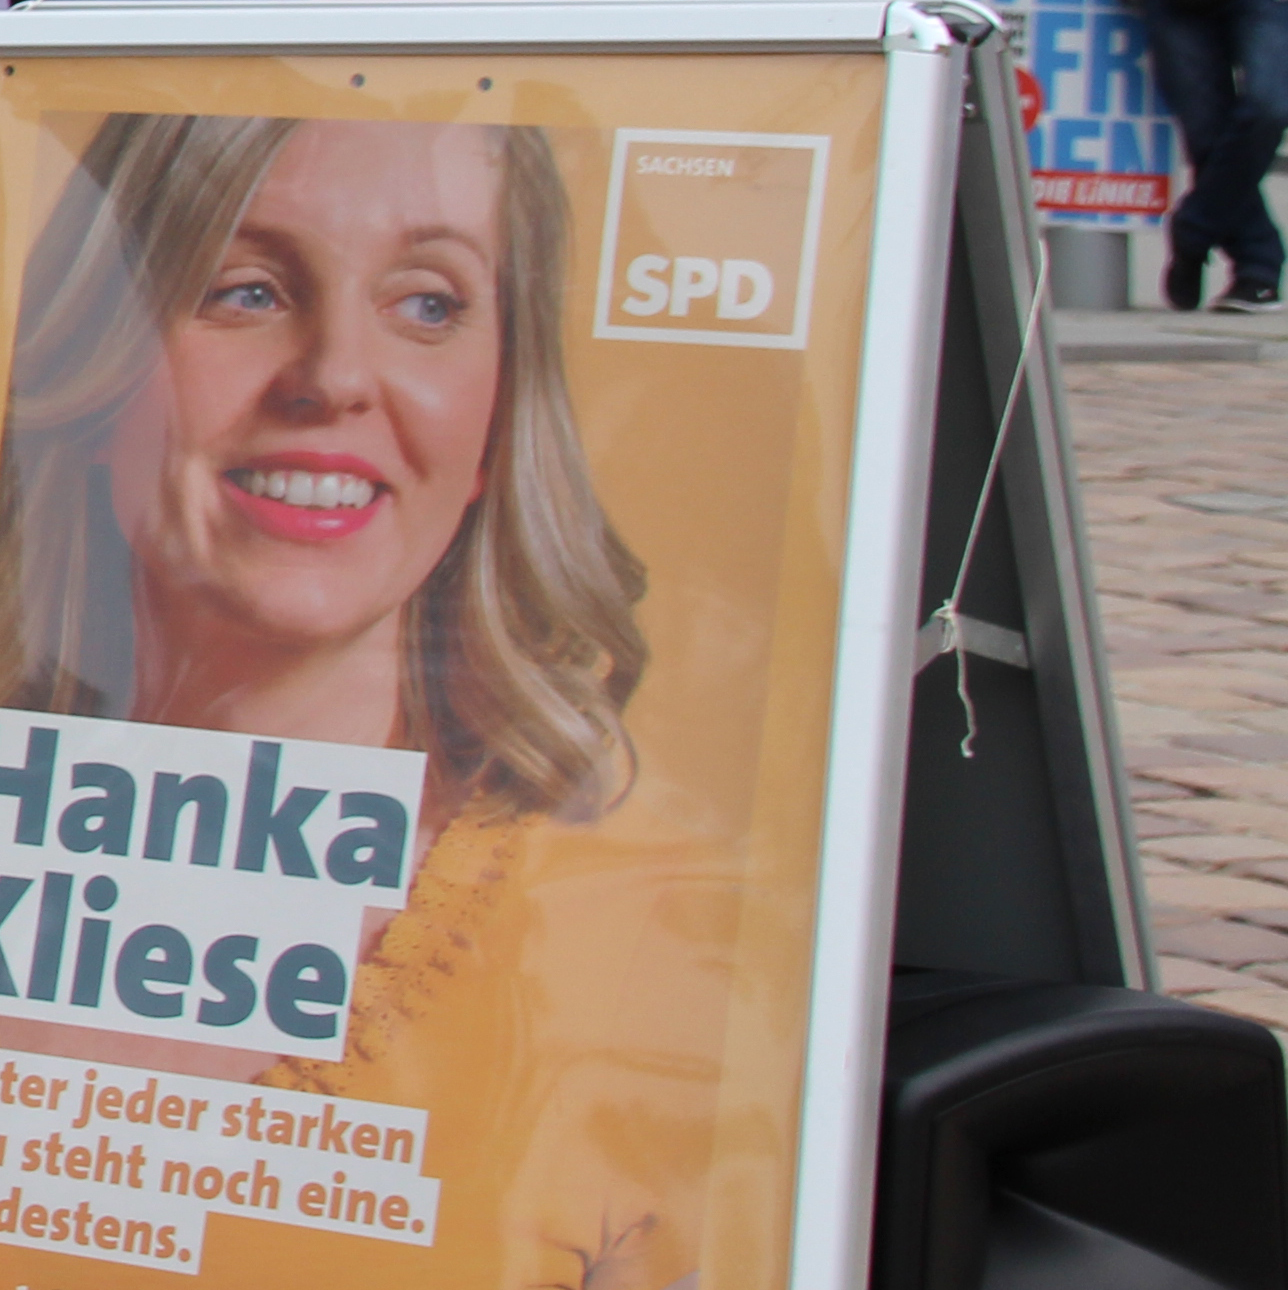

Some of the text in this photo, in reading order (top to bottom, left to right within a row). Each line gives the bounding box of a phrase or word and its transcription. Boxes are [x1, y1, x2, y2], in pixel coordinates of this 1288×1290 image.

[636, 155, 736, 177] SACHSEN
[621, 253, 774, 320] SPD
[73, 1069, 208, 1131] jeder
[221, 1096, 415, 1164] starken
[21, 1134, 146, 1188] steht
[160, 1157, 280, 1210] noch
[296, 1171, 425, 1234] eine.
